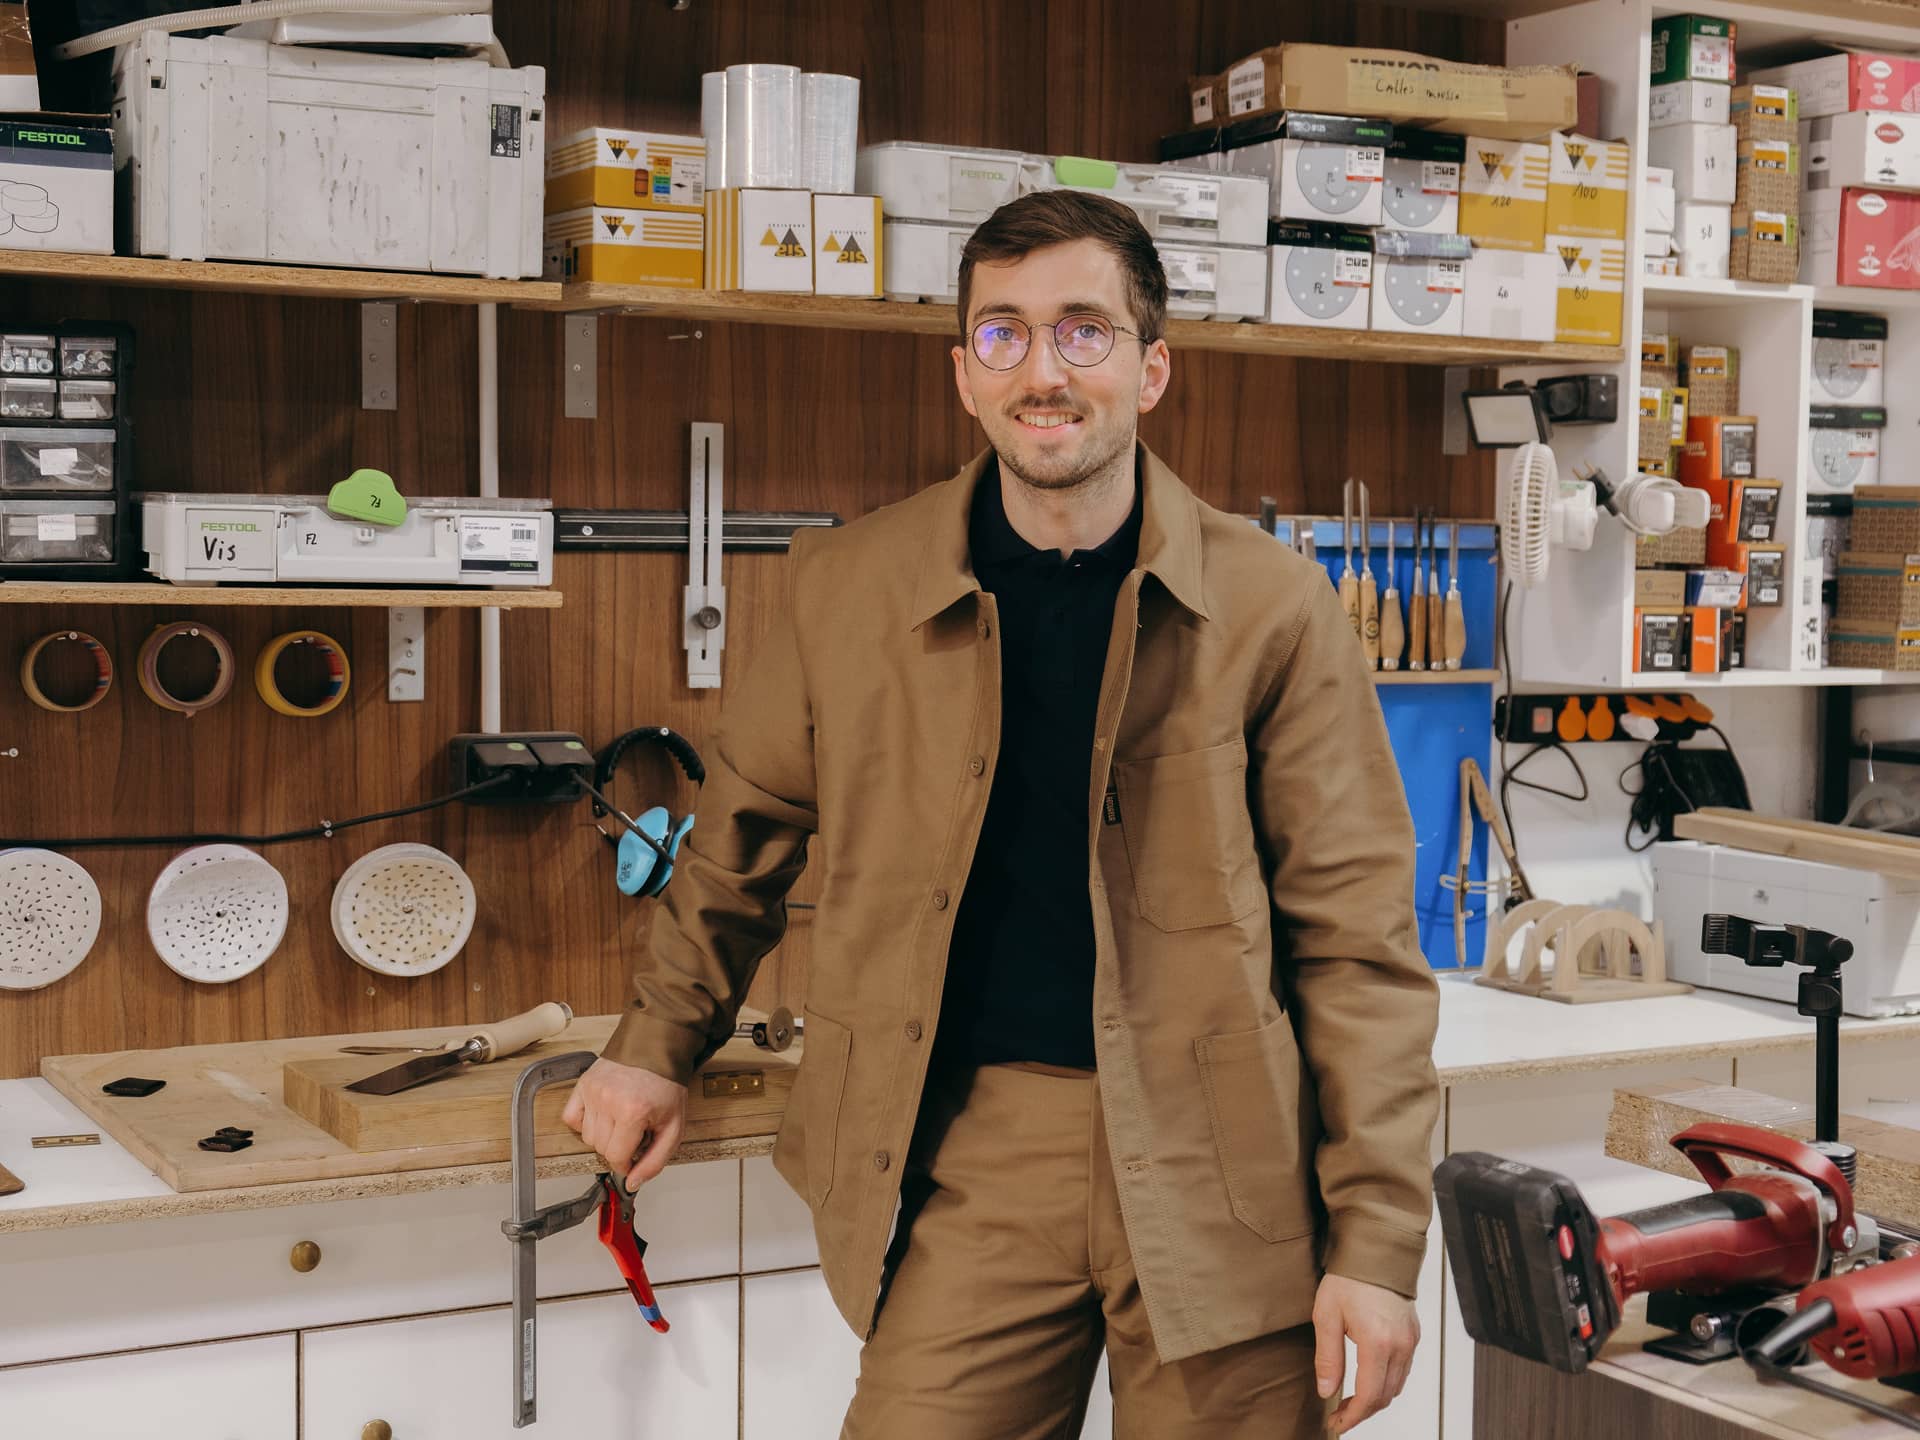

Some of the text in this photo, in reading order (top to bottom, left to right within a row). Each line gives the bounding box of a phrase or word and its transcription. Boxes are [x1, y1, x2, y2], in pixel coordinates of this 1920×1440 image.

[18, 130, 87, 146] FESTOOL
[960, 168, 1008, 181] FESTOOL
[200, 522, 263, 532] FESTOOL
[203, 535, 236, 561] Vis
